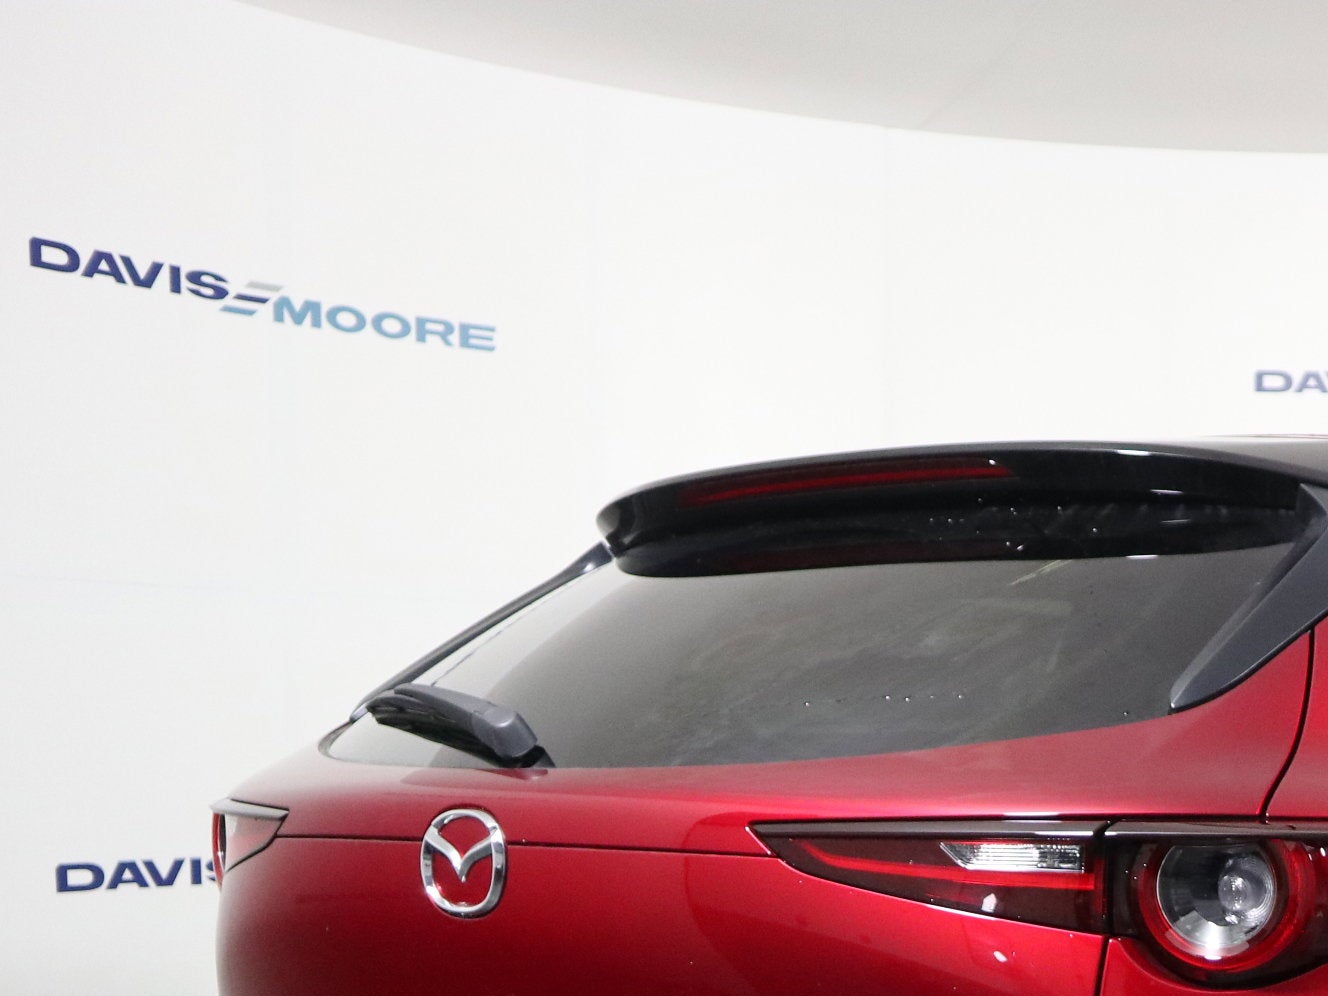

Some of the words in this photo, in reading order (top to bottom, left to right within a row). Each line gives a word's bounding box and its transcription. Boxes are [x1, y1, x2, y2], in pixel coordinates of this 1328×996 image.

[28, 236, 230, 301] DAVIS
[272, 296, 497, 352] MOORE
[56, 857, 216, 893] DAVI
